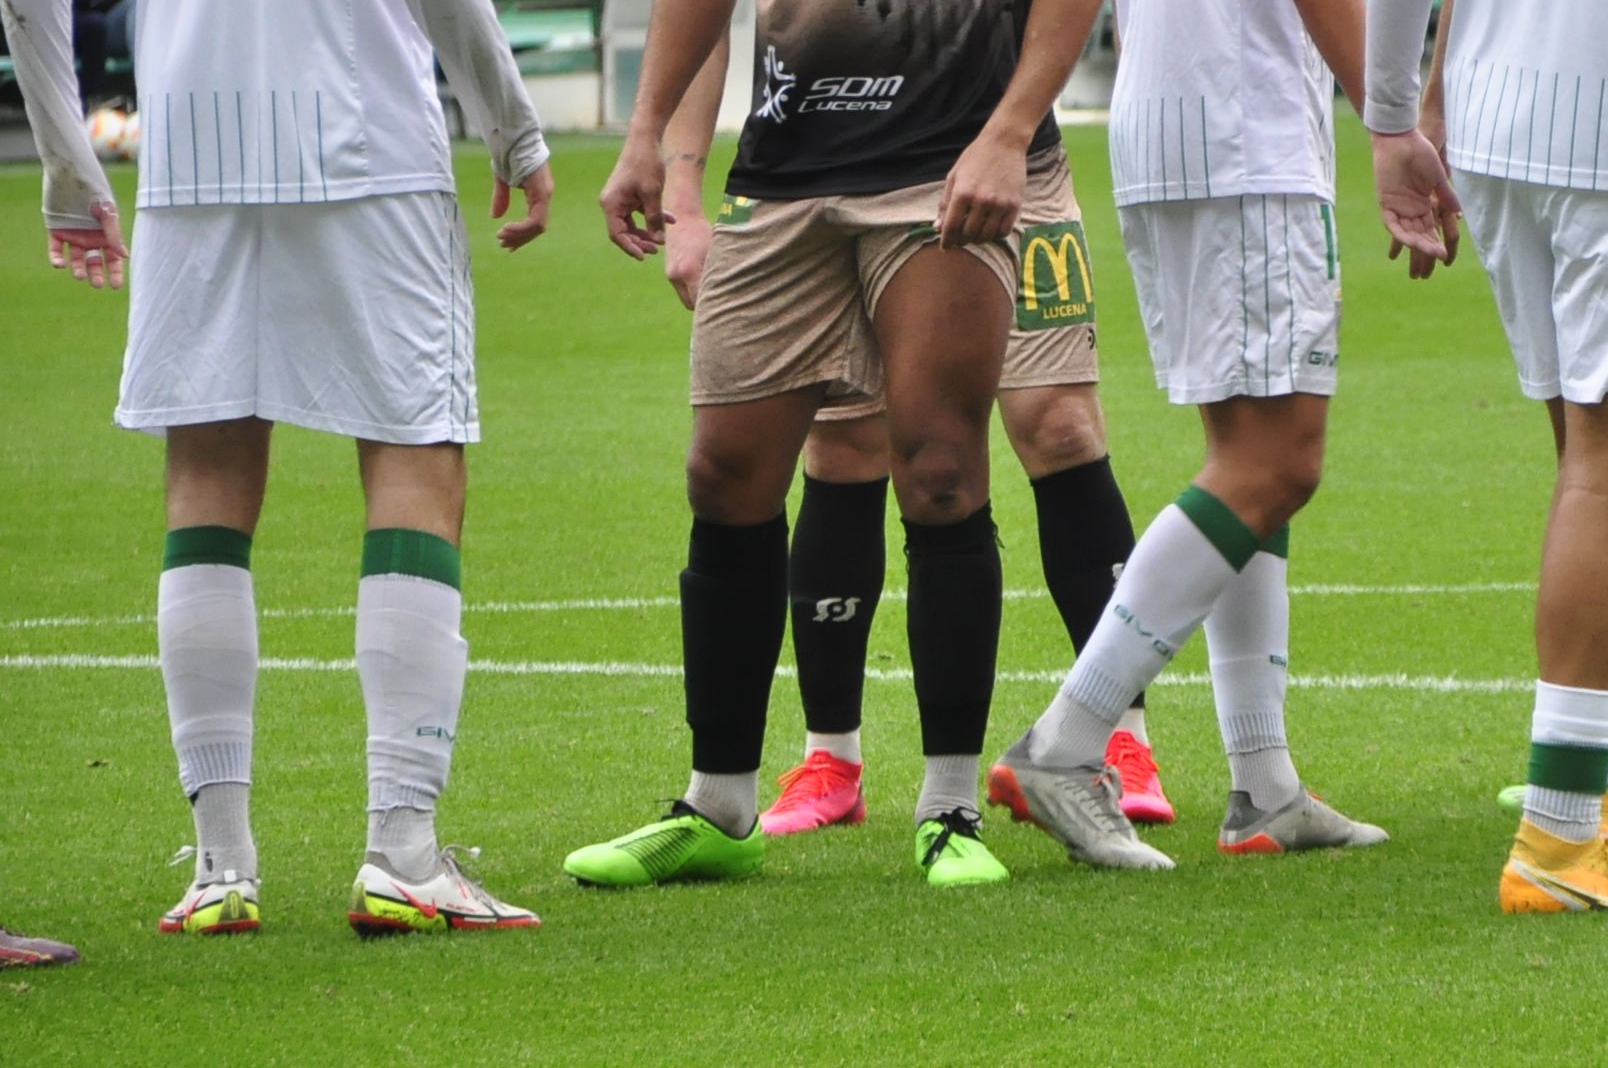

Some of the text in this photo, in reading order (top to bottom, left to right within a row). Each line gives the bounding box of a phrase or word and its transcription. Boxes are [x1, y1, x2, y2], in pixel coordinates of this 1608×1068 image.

[805, 74, 905, 99] SDM
[797, 99, 893, 113] Lucena
[1042, 303, 1088, 320] LUCENA
